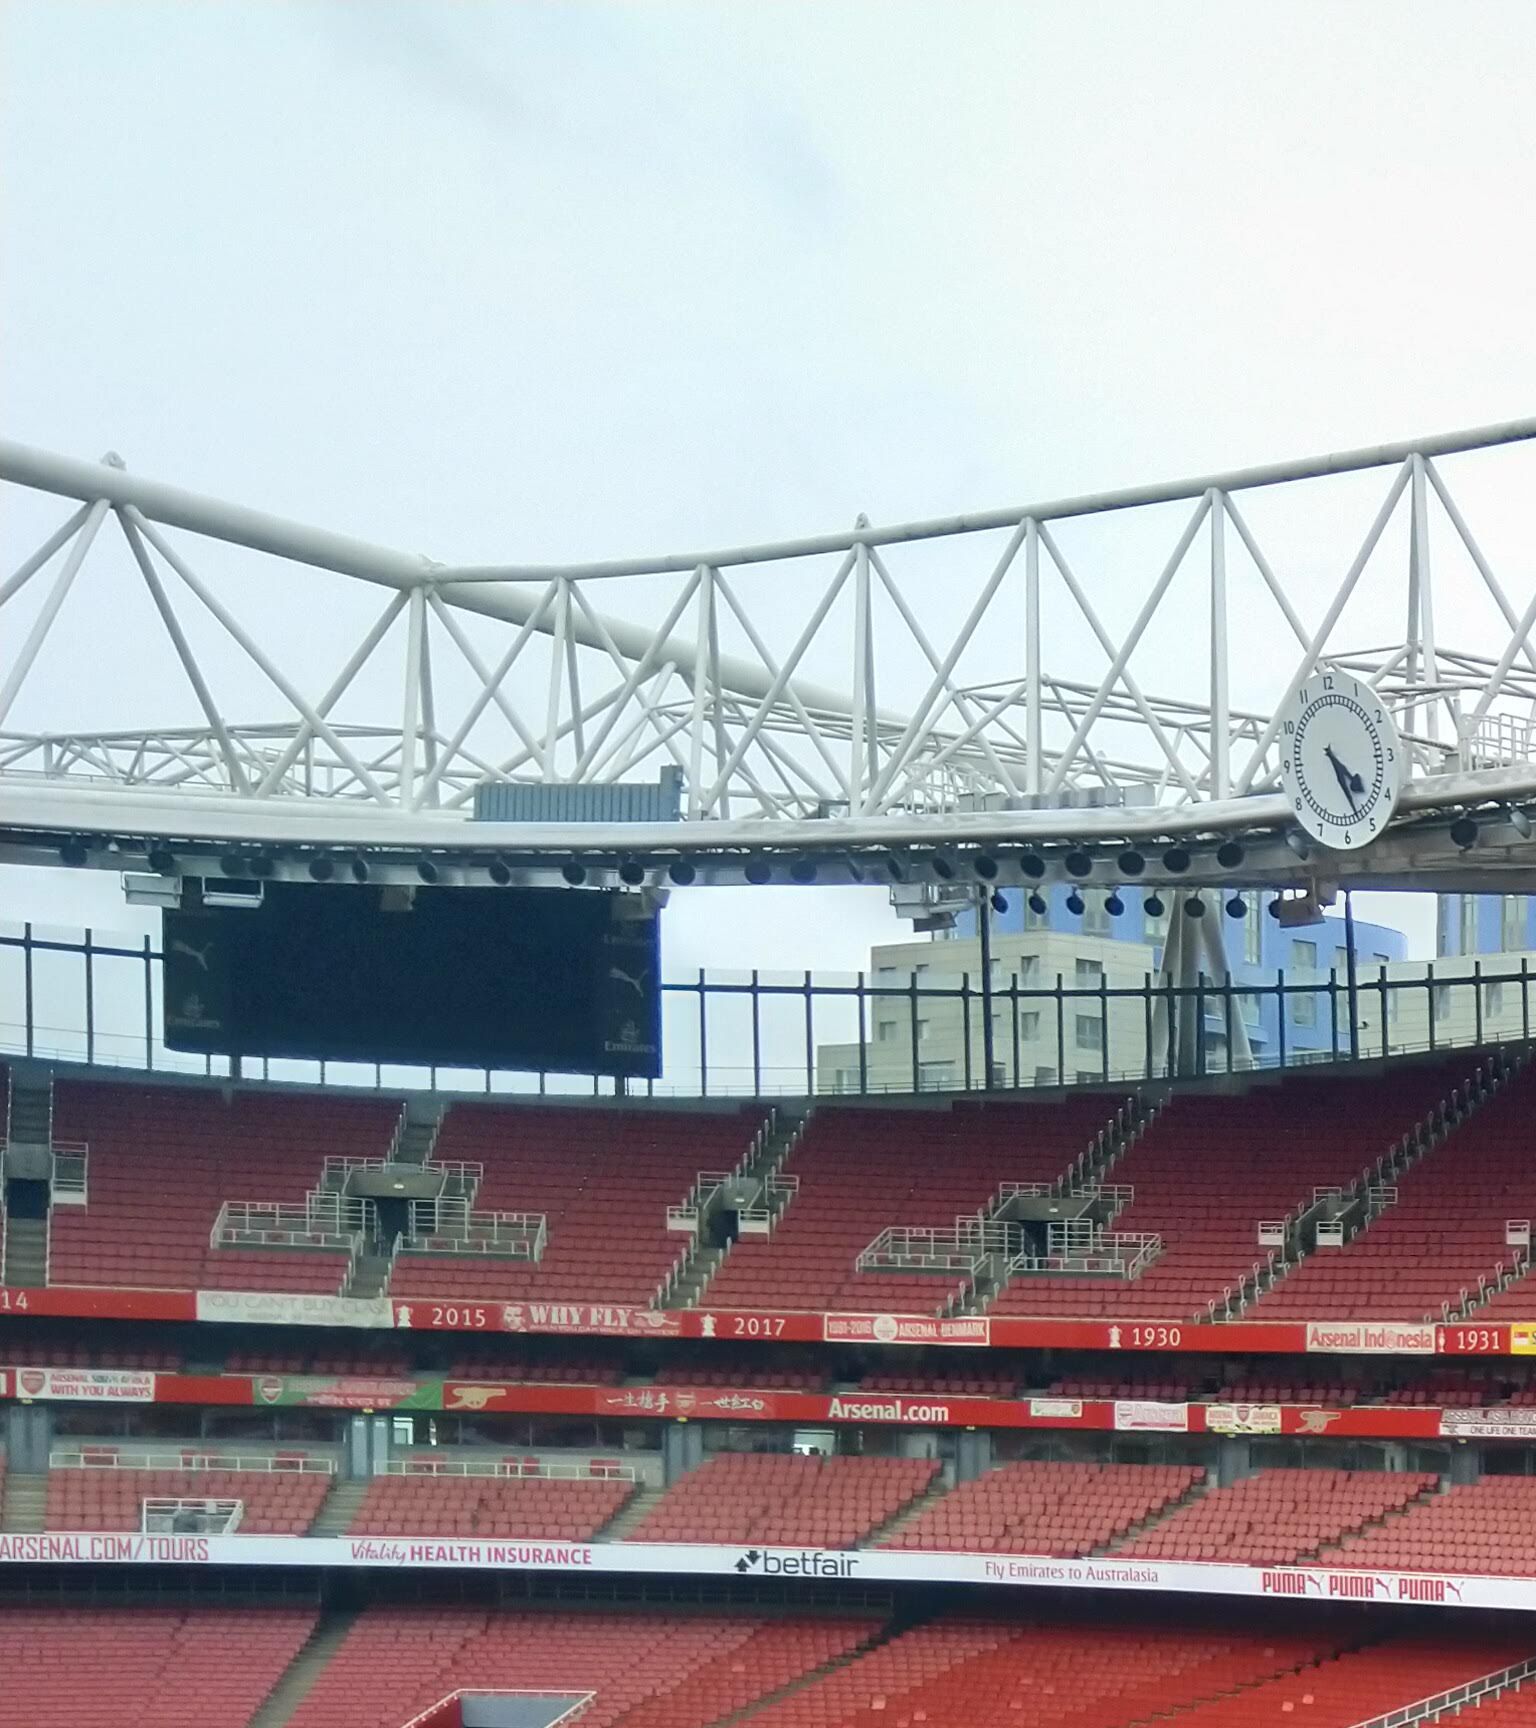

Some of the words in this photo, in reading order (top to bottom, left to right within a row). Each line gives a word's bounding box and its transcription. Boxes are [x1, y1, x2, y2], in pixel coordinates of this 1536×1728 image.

[1323, 675, 1334, 691] 12
[1354, 683, 1359, 697] 1
[1299, 689, 1309, 705] 11
[1375, 709, 1383, 724] 2
[1284, 720, 1294, 735] 10
[1387, 748, 1394, 762] 3
[1284, 760, 1290, 774] 9
[1384, 787, 1392, 801] 4
[1296, 797, 1303, 811] 8
[1317, 823, 1324, 837] 7
[1369, 817, 1376, 832] 5
[1345, 830, 1352, 845] 6
[604, 1040, 656, 1053] Emirates
[432, 1307, 486, 1327] 2015
[529, 1305, 584, 1326] WHY
[590, 1307, 633, 1328] FLY
[734, 1317, 785, 1336] 2017
[899, 1322, 938, 1337] ARSENAL
[1133, 1328, 1181, 1346] 1930
[1310, 1328, 1360, 1347] Arsenal
[1457, 1330, 1500, 1350] 1931
[50, 1384, 79, 1396] WITH
[82, 1385, 104, 1397] YOU
[107, 1386, 151, 1398] ALWAYS
[828, 1398, 949, 1422] Arsenal.com
[1470, 1426, 1485, 1435] ONE
[1487, 1426, 1501, 1435] LIFE
[1502, 1426, 1518, 1435] ONE
[0, 1536, 210, 1562] ARSENAL.COM/TOURS
[351, 1540, 406, 1566] Vitality
[410, 1545, 481, 1563] HEALTH
[487, 1546, 592, 1565] INSURANCE
[763, 1552, 859, 1577] betfair
[985, 1561, 1005, 1580] Fly
[1009, 1562, 1065, 1580] Emirates
[1068, 1567, 1082, 1581] to
[1086, 1565, 1159, 1584] Australasia
[1262, 1572, 1306, 1594] PUMA
[1329, 1575, 1374, 1598] PUMA
[1399, 1578, 1445, 1602] PUMA
